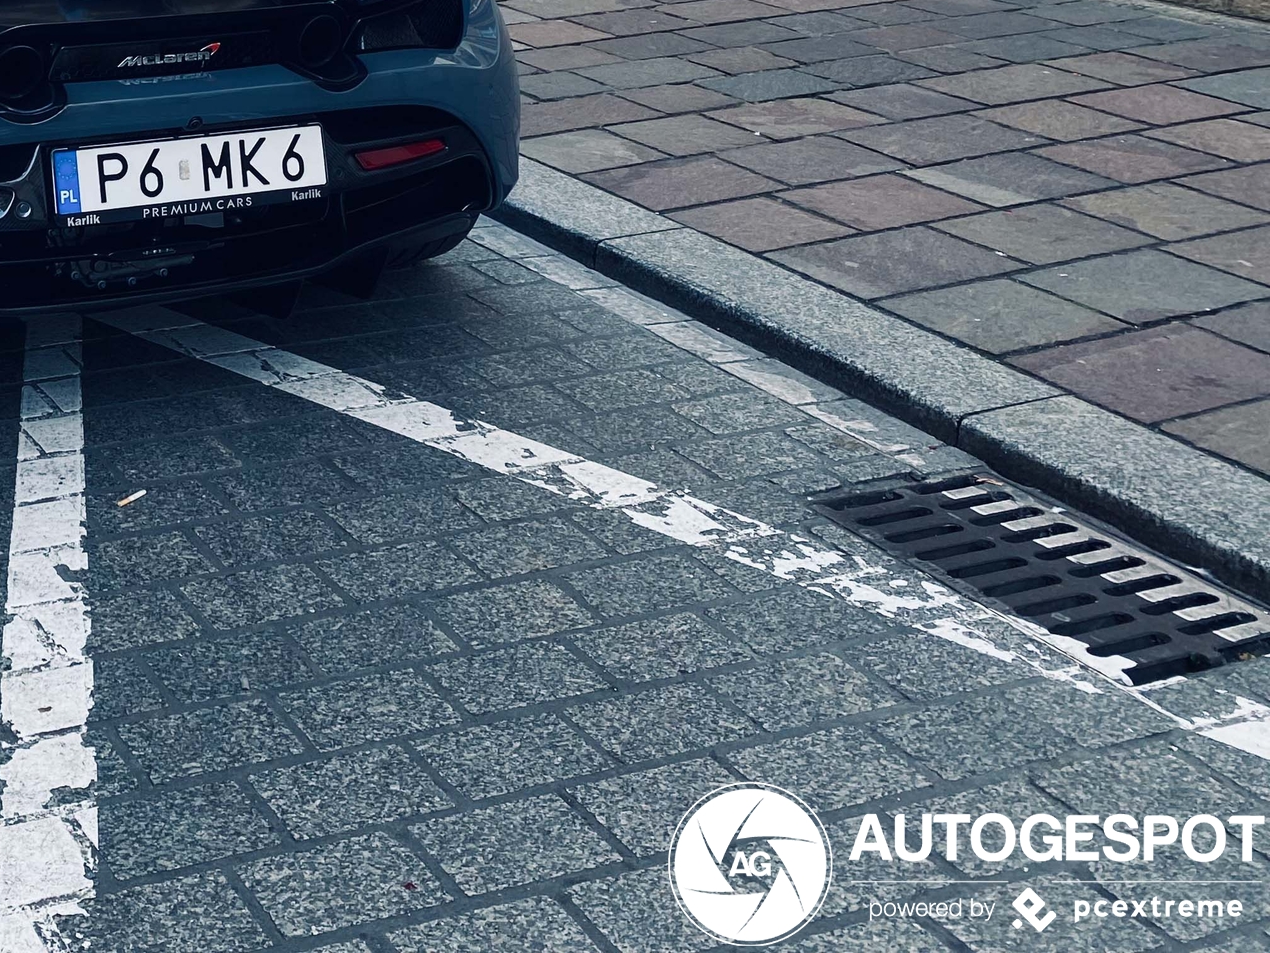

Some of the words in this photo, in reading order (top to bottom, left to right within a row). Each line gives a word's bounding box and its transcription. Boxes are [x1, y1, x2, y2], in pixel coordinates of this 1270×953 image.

[117, 48, 212, 68] McLaren
[97, 148, 164, 203] P6
[200, 133, 305, 192] MK6
[60, 190, 78, 204] PL
[291, 189, 321, 201] Karlik
[143, 201, 212, 218] PREMIUM
[216, 196, 253, 210] CARS
[67, 214, 101, 227] Karlik
